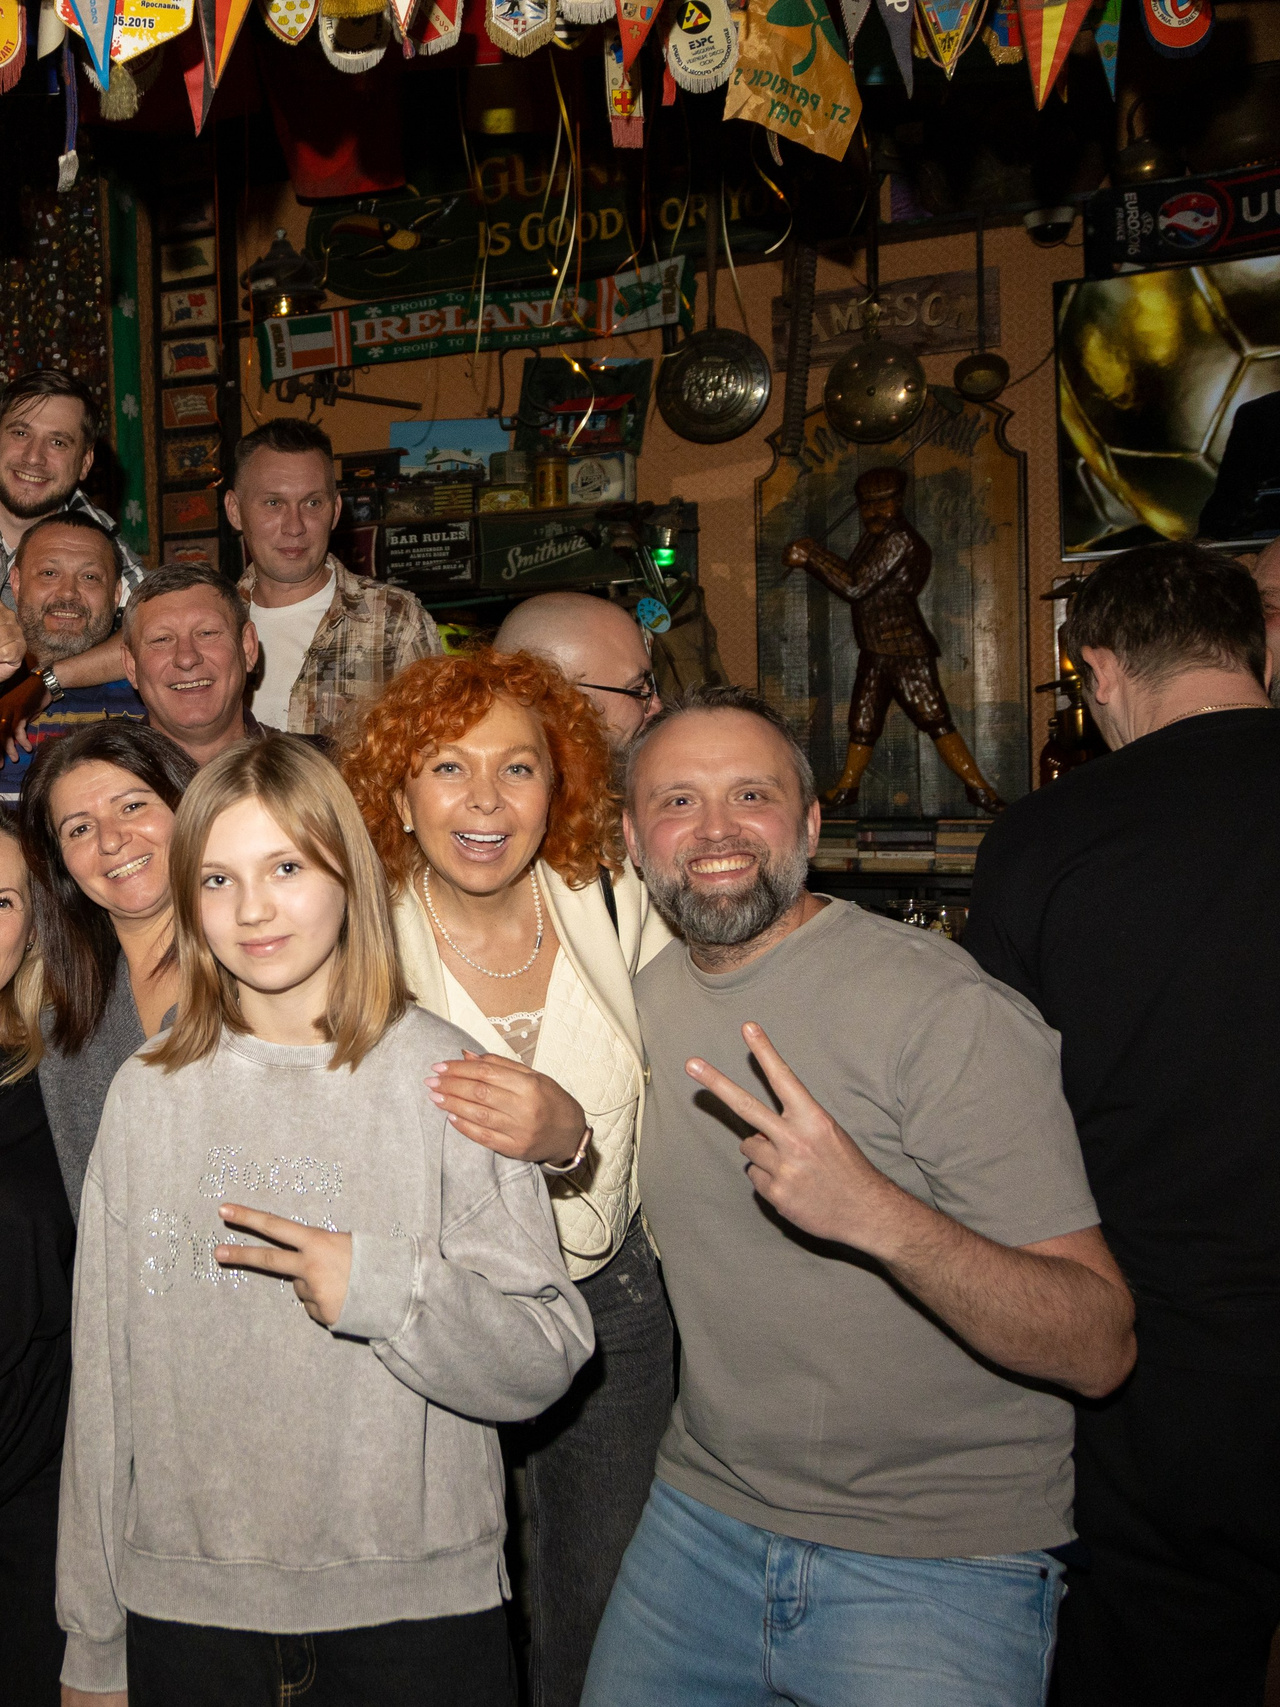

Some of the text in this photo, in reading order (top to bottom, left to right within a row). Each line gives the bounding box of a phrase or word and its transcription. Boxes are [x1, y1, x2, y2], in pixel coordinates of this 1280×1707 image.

[140, 1, 180, 11] Ярославль
[688, 35, 715, 50] ESPC
[518, 207, 624, 252] GOOD
[390, 295, 438, 312] PROUD
[445, 291, 466, 303] TO
[351, 297, 592, 347] IRELAND
[392, 340, 440, 356] PROUD
[446, 337, 466, 348] TO
[502, 331, 551, 344] IRISH
[390, 530, 466, 546] BAR RULES
